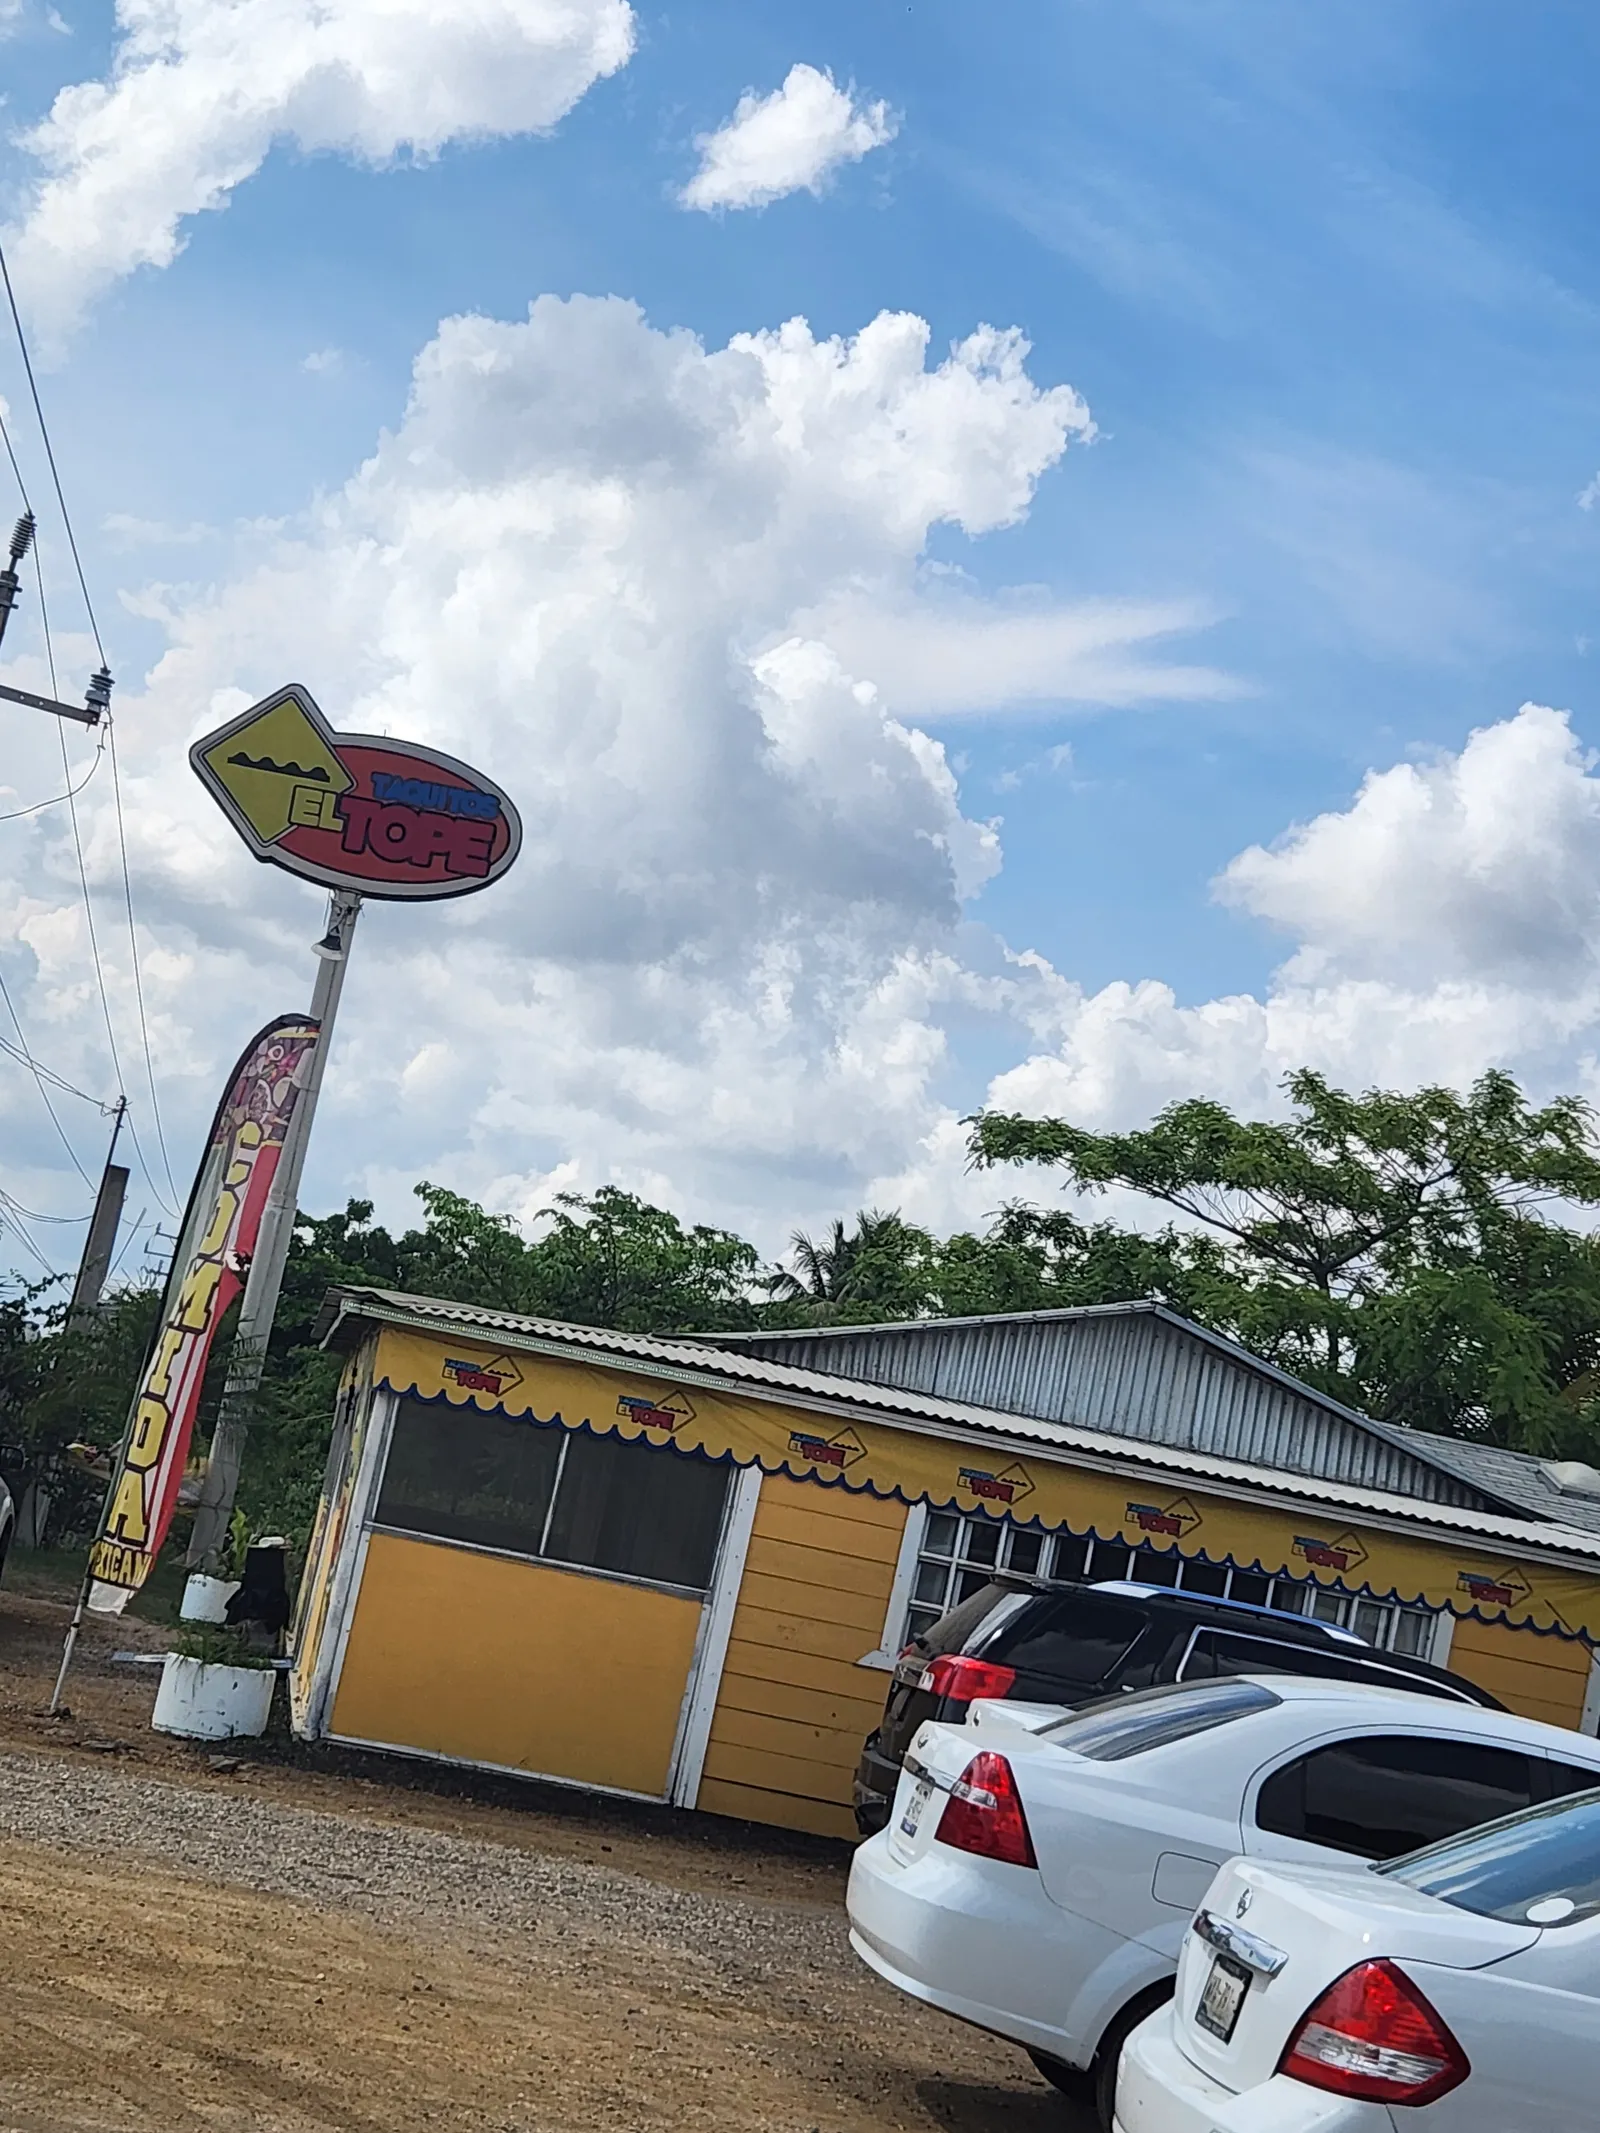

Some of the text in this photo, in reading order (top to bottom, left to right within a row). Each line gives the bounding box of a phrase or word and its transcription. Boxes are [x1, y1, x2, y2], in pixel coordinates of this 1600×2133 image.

[371, 771, 501, 819] TAQUITOS
[288, 785, 497, 878] EL TOPE
[105, 1118, 264, 1546] COMIDA
[443, 1367, 502, 1396] EL TOPE
[616, 1404, 675, 1432] EL TOPE
[788, 1439, 846, 1468] EL TOPE
[957, 1475, 1014, 1504] EL TOPE
